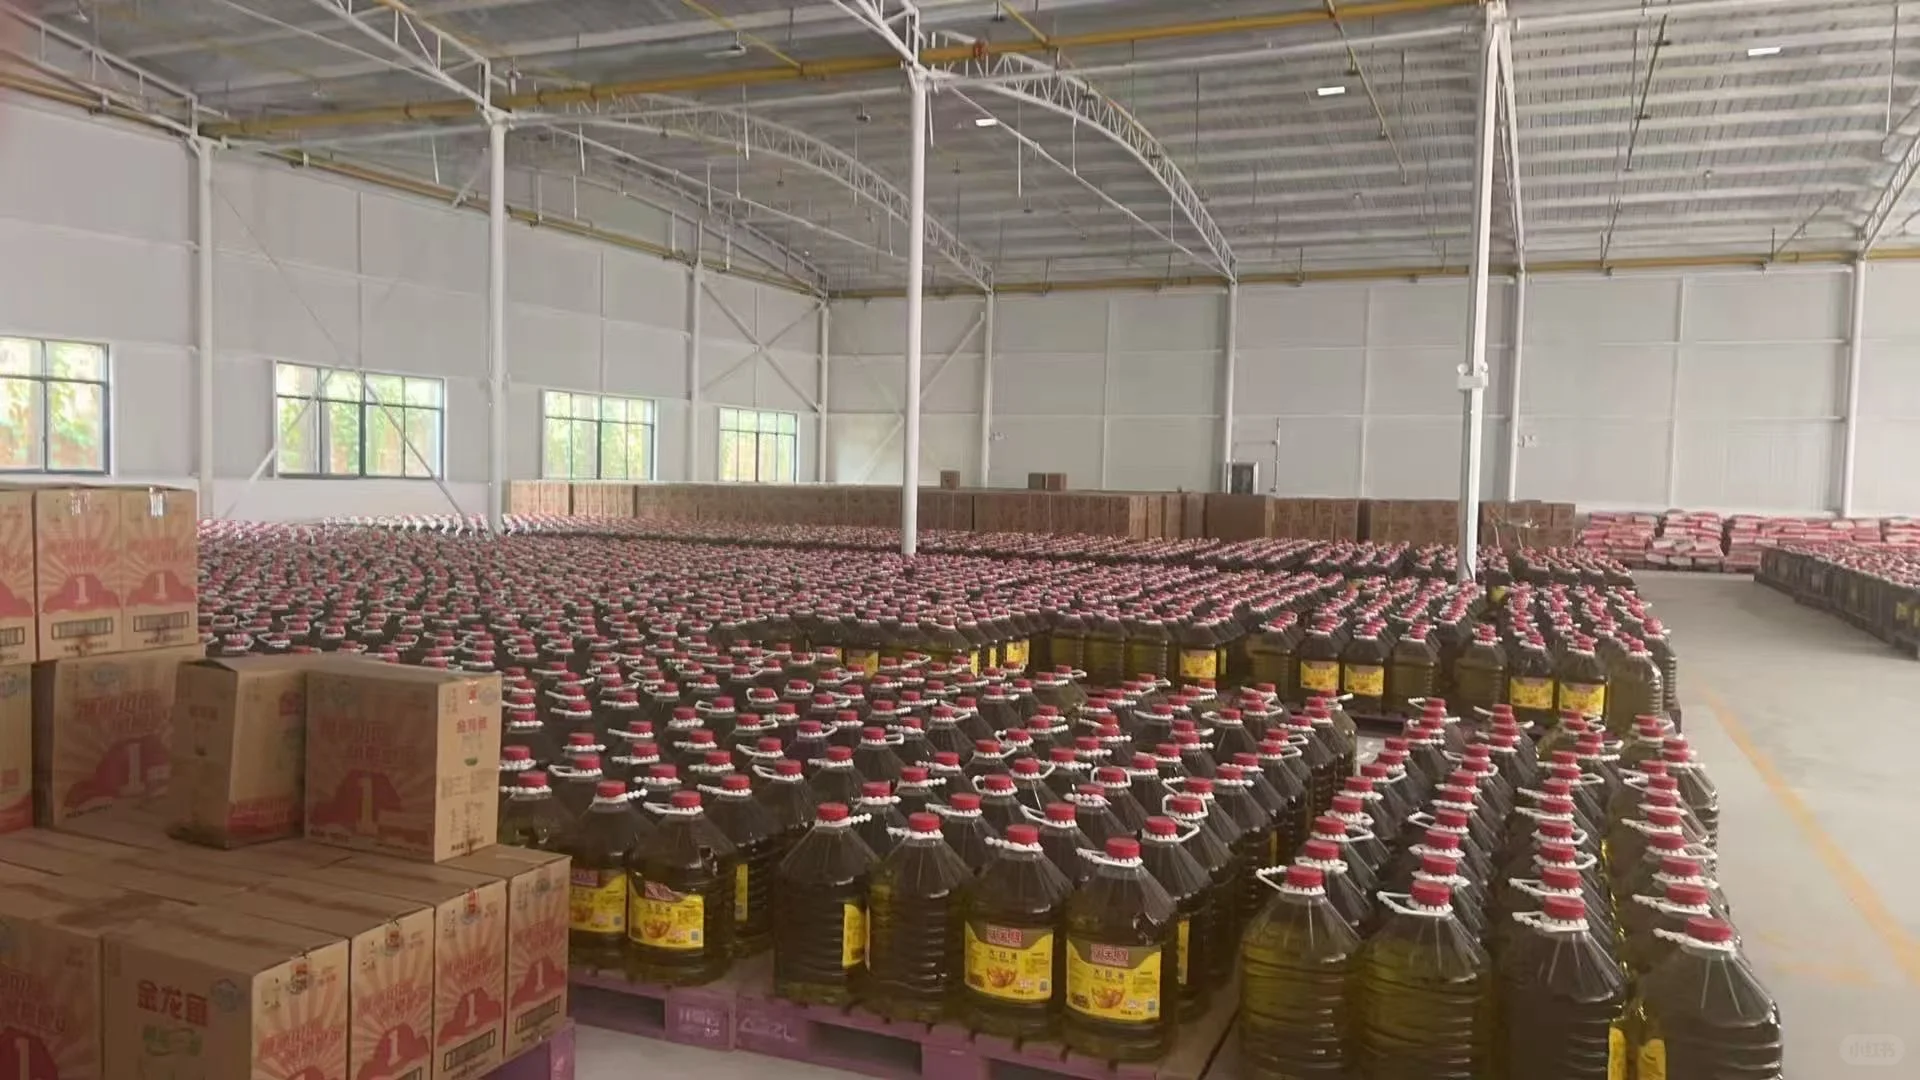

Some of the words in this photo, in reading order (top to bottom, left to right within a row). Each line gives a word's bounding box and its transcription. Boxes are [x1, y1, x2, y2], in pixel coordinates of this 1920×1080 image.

[74, 576, 90, 604] 1
[119, 743, 145, 796] 1
[535, 960, 545, 992] 1
[465, 993, 478, 1027] 1
[387, 1029, 402, 1067] 1
